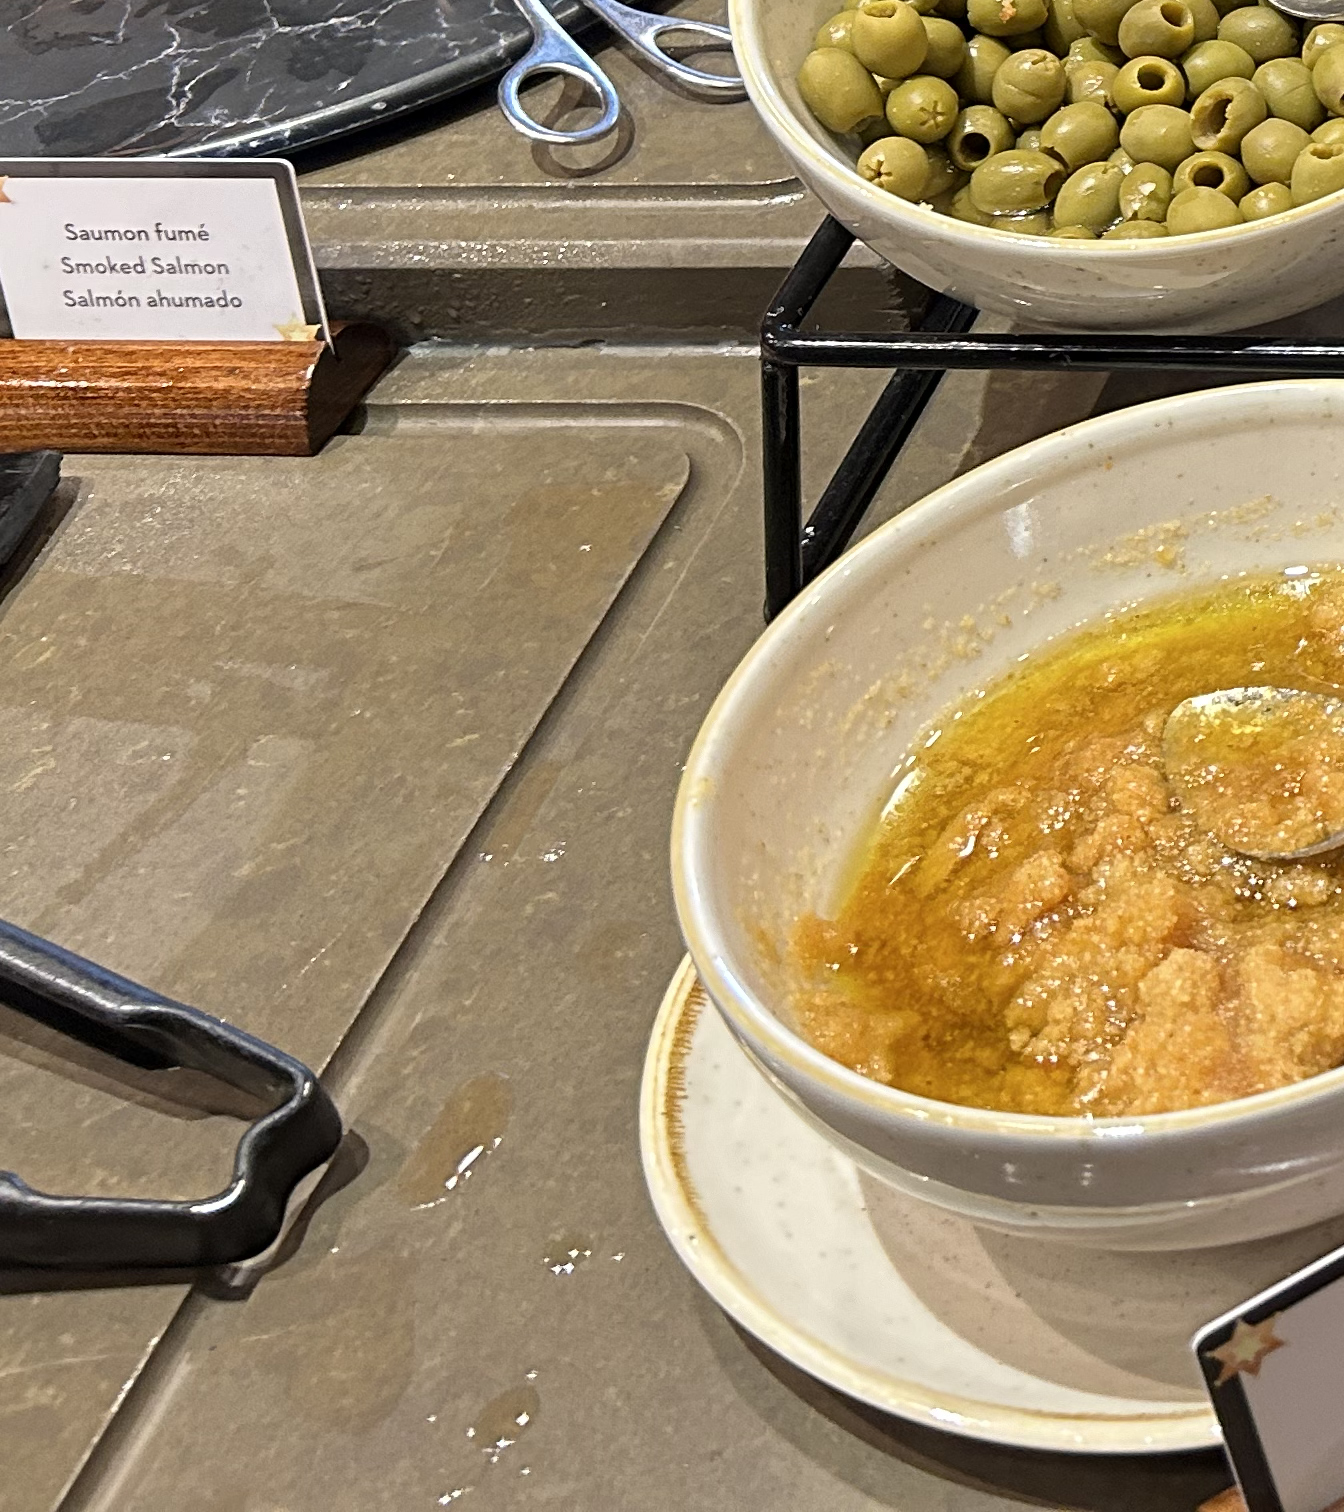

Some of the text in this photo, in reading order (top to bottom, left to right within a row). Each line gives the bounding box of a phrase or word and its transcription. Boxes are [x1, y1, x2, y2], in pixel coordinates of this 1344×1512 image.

[64, 222, 210, 241] Saumon fumé
[61, 256, 230, 275] Smoked Salmon
[63, 289, 243, 308] Salmón ahumado
